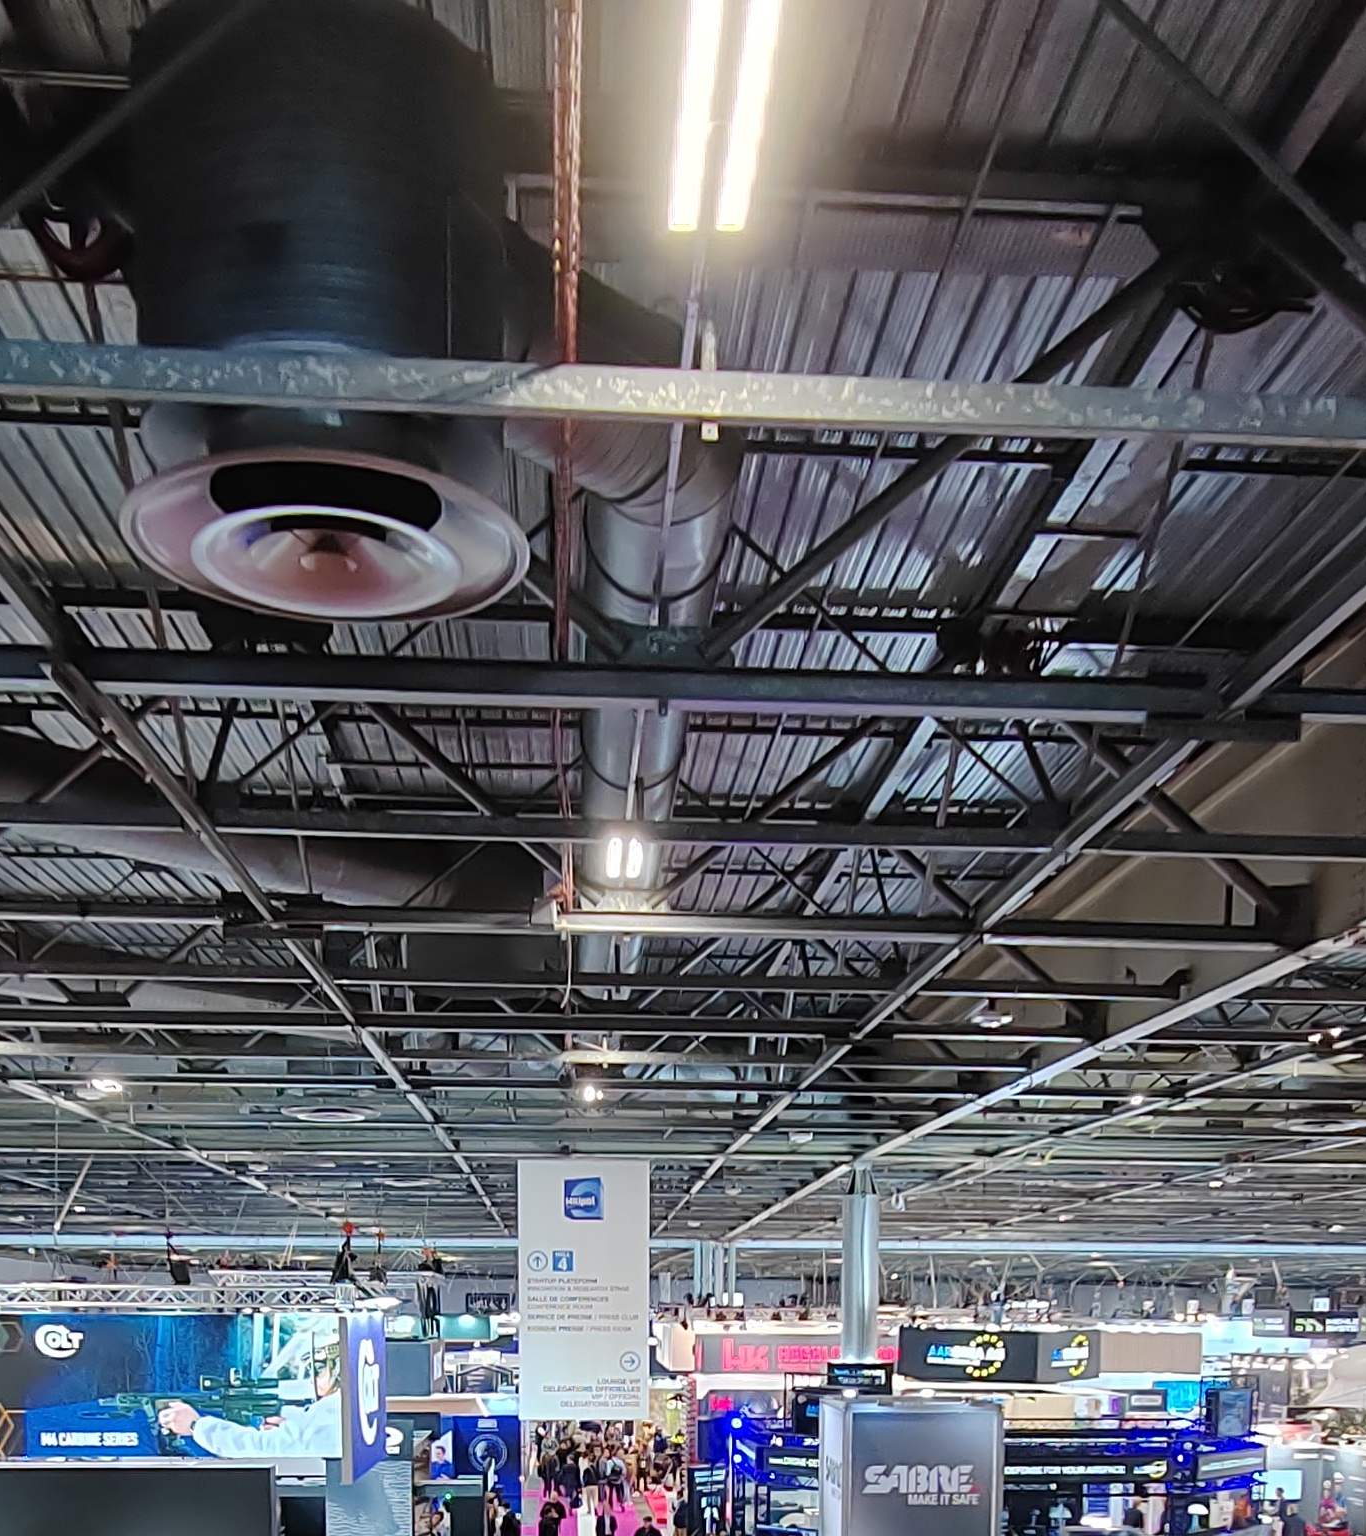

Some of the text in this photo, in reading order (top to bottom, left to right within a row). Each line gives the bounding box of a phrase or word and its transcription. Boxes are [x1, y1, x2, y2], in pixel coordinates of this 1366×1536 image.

[557, 1257, 568, 1271] 4
[34, 1324, 84, 1358] COLT
[862, 1464, 975, 1493] SABRE
[907, 1494, 980, 1505] MAKE IT SAFE
